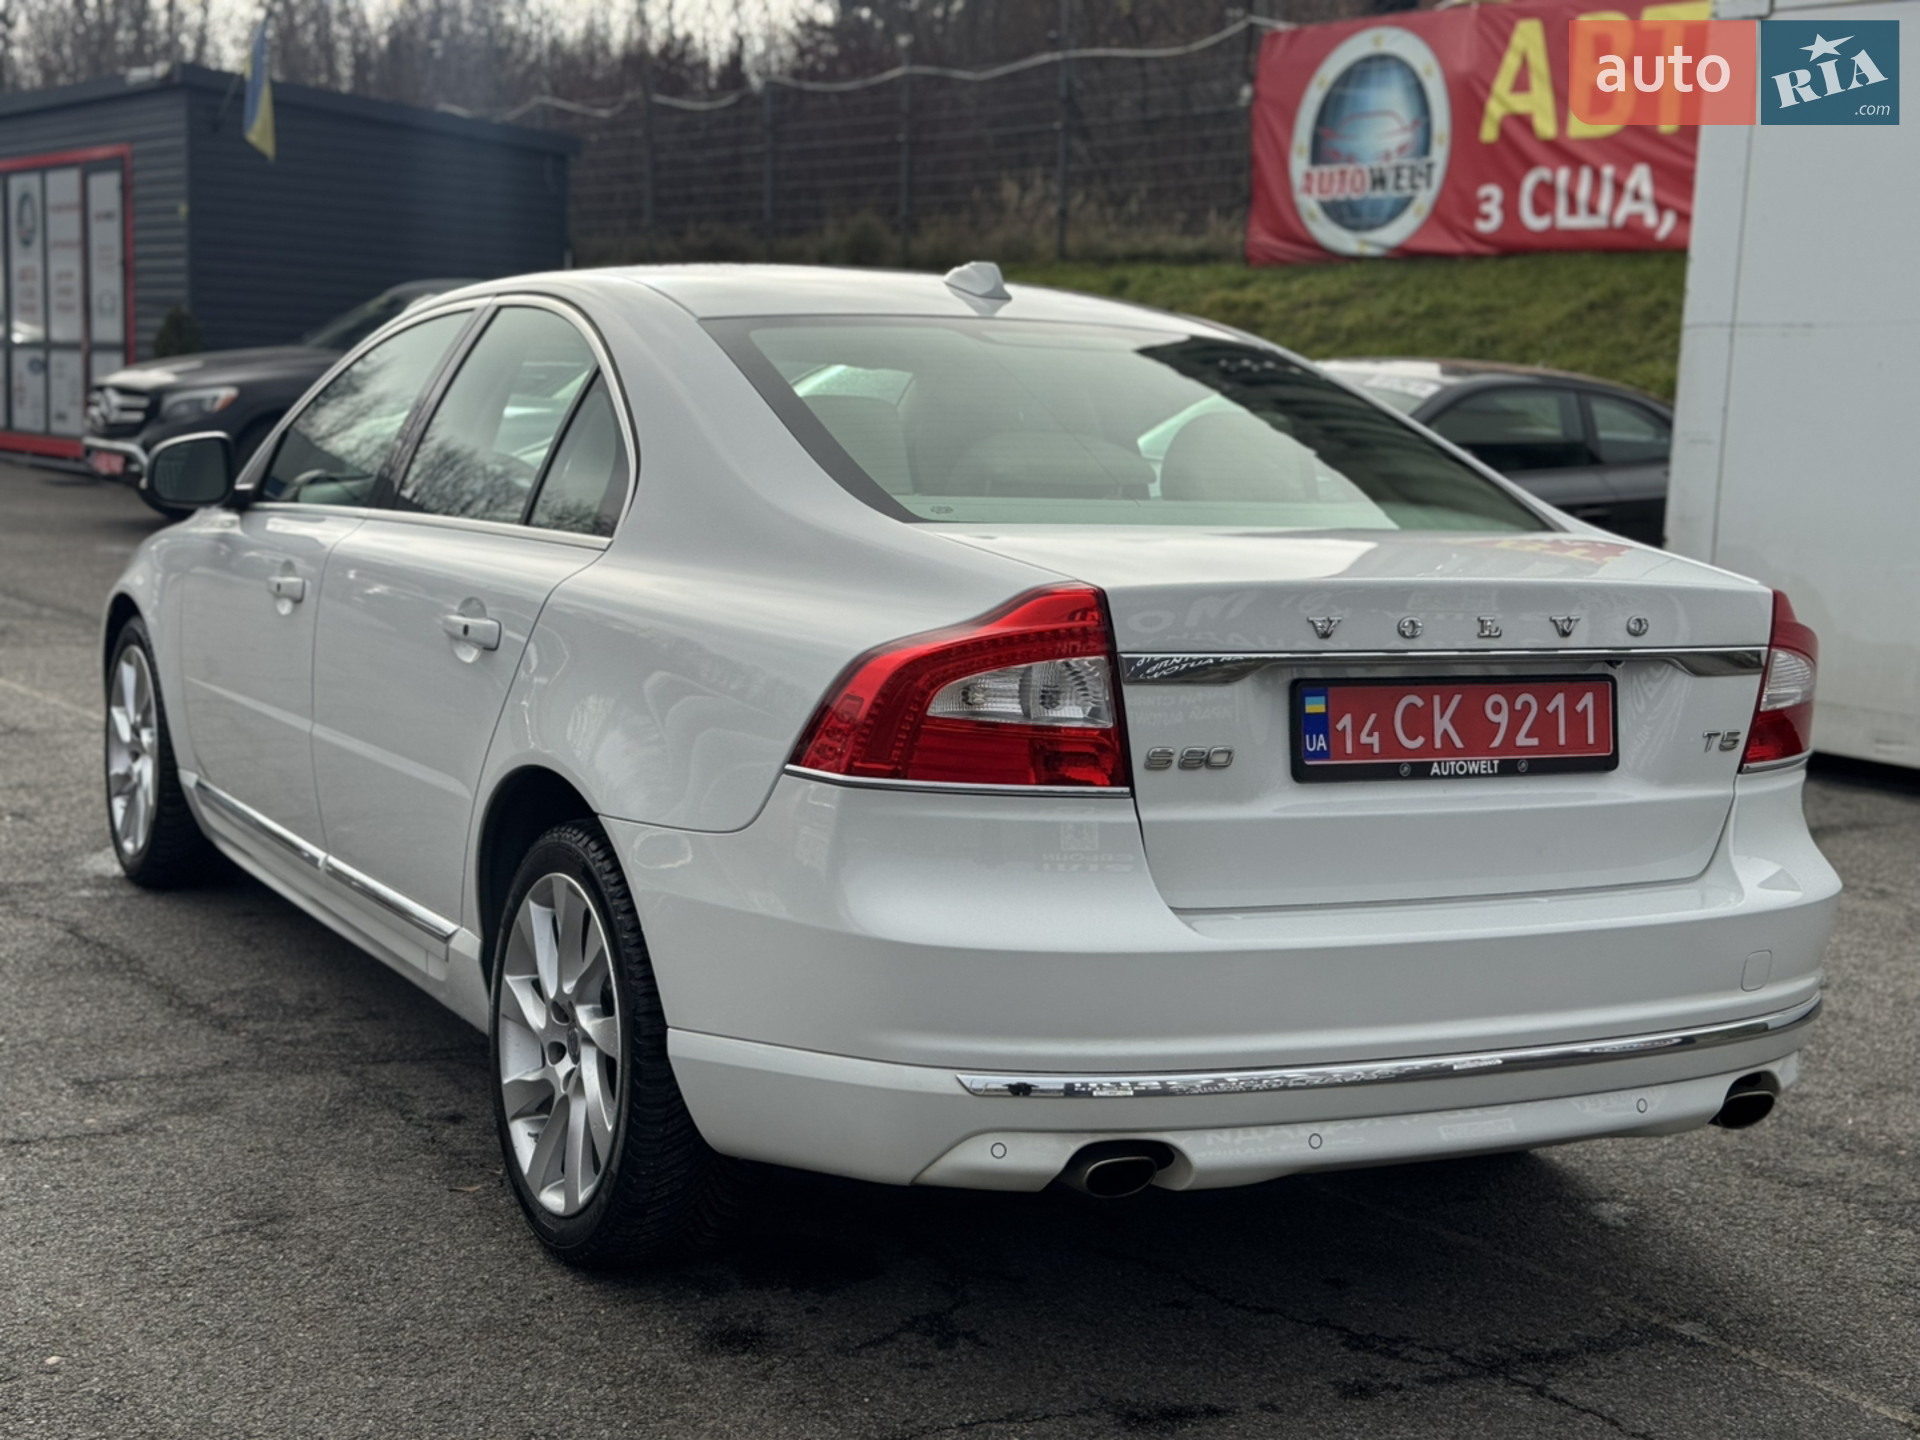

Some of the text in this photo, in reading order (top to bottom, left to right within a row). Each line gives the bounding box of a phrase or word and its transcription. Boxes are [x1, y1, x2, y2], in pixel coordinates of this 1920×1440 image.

[1303, 160, 1436, 196] AUTOWELT
[1518, 162, 1679, 242] США,
[1307, 615, 1649, 639] VOLVO
[1484, 691, 1595, 749] 9211
[1305, 733, 1328, 753] UA
[1703, 730, 1741, 753] T5
[1430, 759, 1500, 776] AUTOWELT
